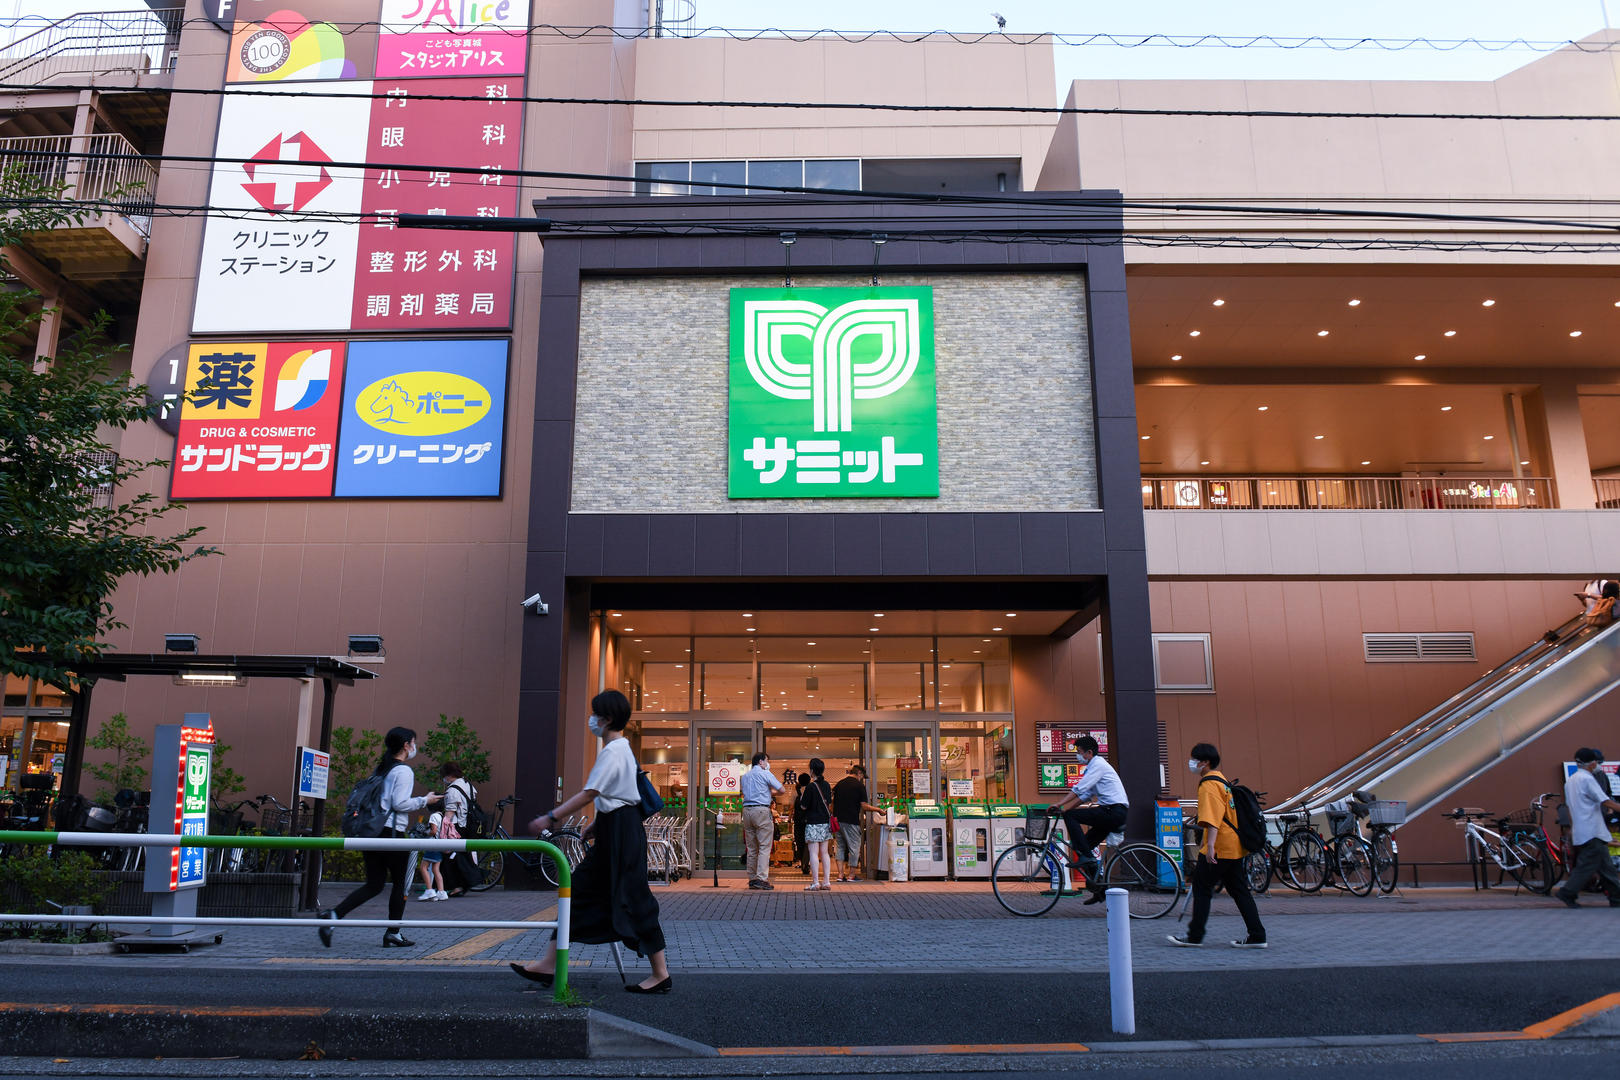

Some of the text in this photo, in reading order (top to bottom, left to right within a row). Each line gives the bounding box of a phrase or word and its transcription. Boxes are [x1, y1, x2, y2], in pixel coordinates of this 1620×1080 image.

[421, 0, 511, 29] Alice
[250, 32, 263, 41] YEN
[266, 31, 287, 44] GOODS
[425, 38, 482, 48] こども写真城
[251, 43, 281, 61] 100
[274, 48, 289, 68] COLOR
[399, 49, 505, 69] スタジオアリス
[233, 229, 329, 249] クリニック
[219, 255, 336, 275] ステーション
[369, 249, 498, 273] 整形外科
[366, 293, 494, 317] 調剤薬局
[195, 352, 256, 410] 薬
[416, 391, 483, 414] ポニー
[200, 426, 317, 438] DRUG & COSMETIC
[180, 443, 332, 472] サンドラッグ
[353, 441, 492, 465] クリーニング
[743, 436, 924, 484] サミット
[186, 796, 205, 810] サミット
[181, 859, 202, 878] 営業
